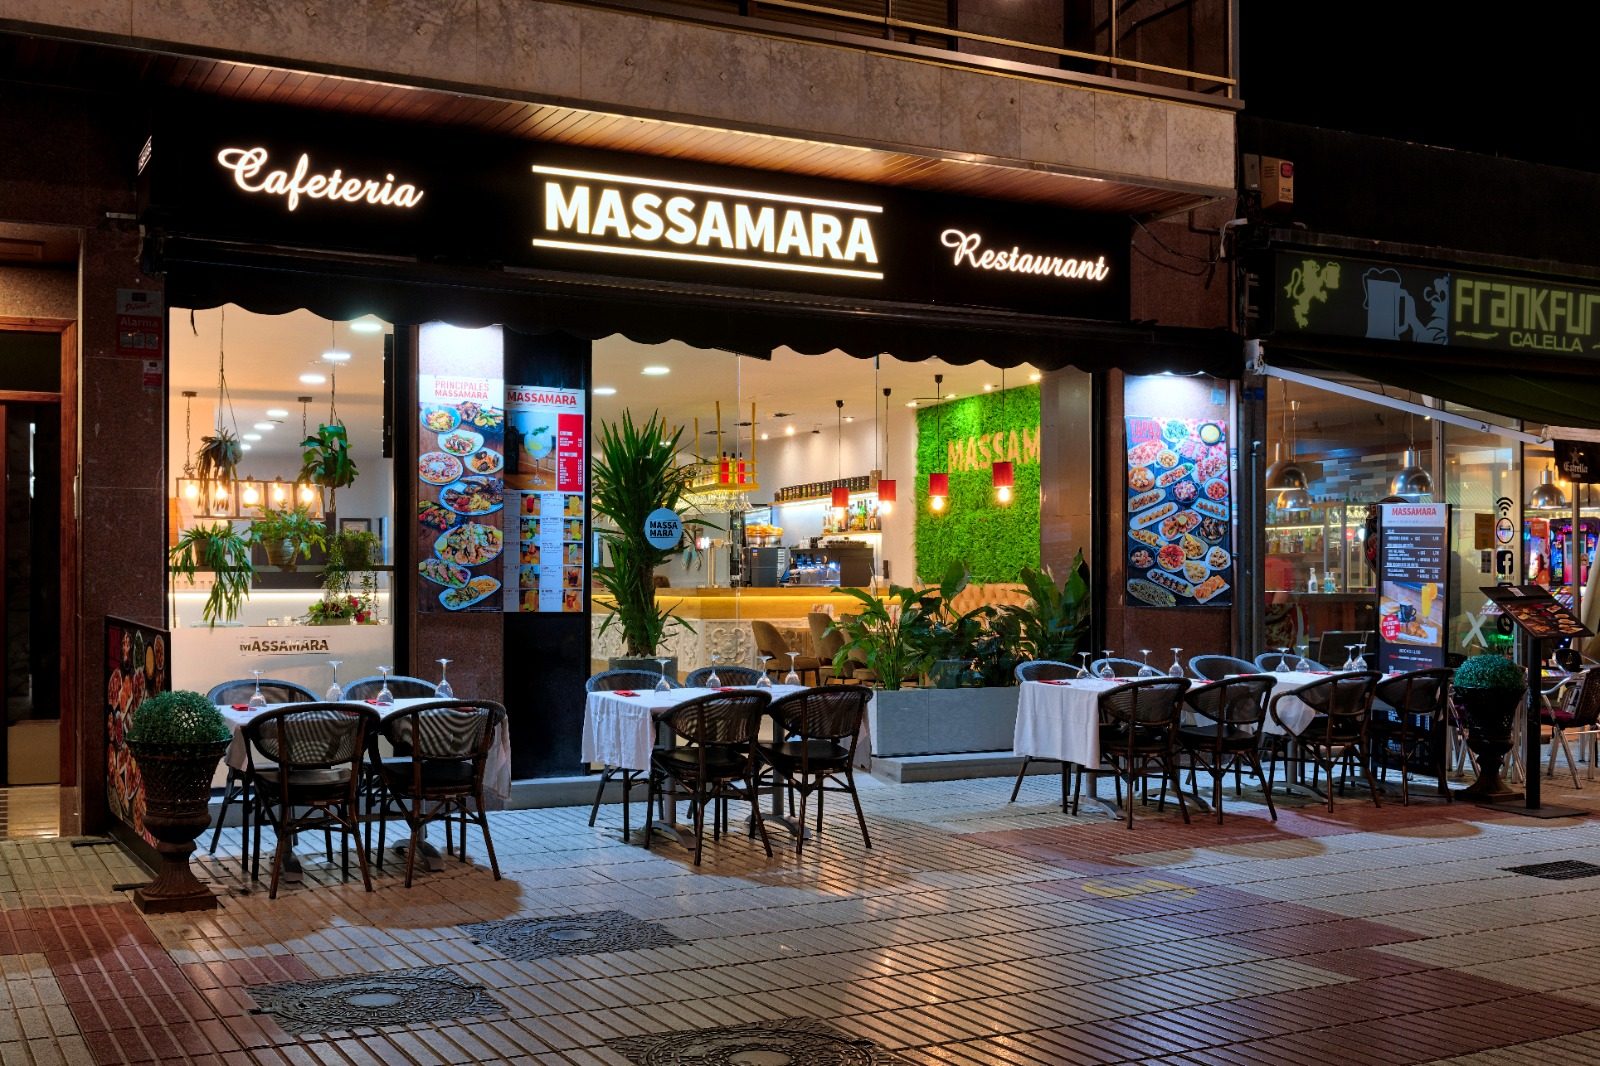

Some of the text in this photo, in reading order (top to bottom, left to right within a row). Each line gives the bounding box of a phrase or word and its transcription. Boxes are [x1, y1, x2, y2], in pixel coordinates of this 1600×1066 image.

[217, 147, 424, 212] Cafeteria
[544, 181, 879, 264] MASSAMARA
[940, 228, 1110, 283] Restaurant
[1509, 330, 1584, 353] CALELLA
[434, 380, 490, 392] PRINCIPALES
[434, 388, 489, 400] MASSAMARA
[507, 391, 577, 405] MASSAMARA
[1563, 461, 1589, 473] Estrella
[1391, 507, 1437, 516] MASSAMARA
[649, 521, 678, 529] MASSA
[649, 529, 674, 537] MARA
[239, 639, 329, 652] MASSAMARA
